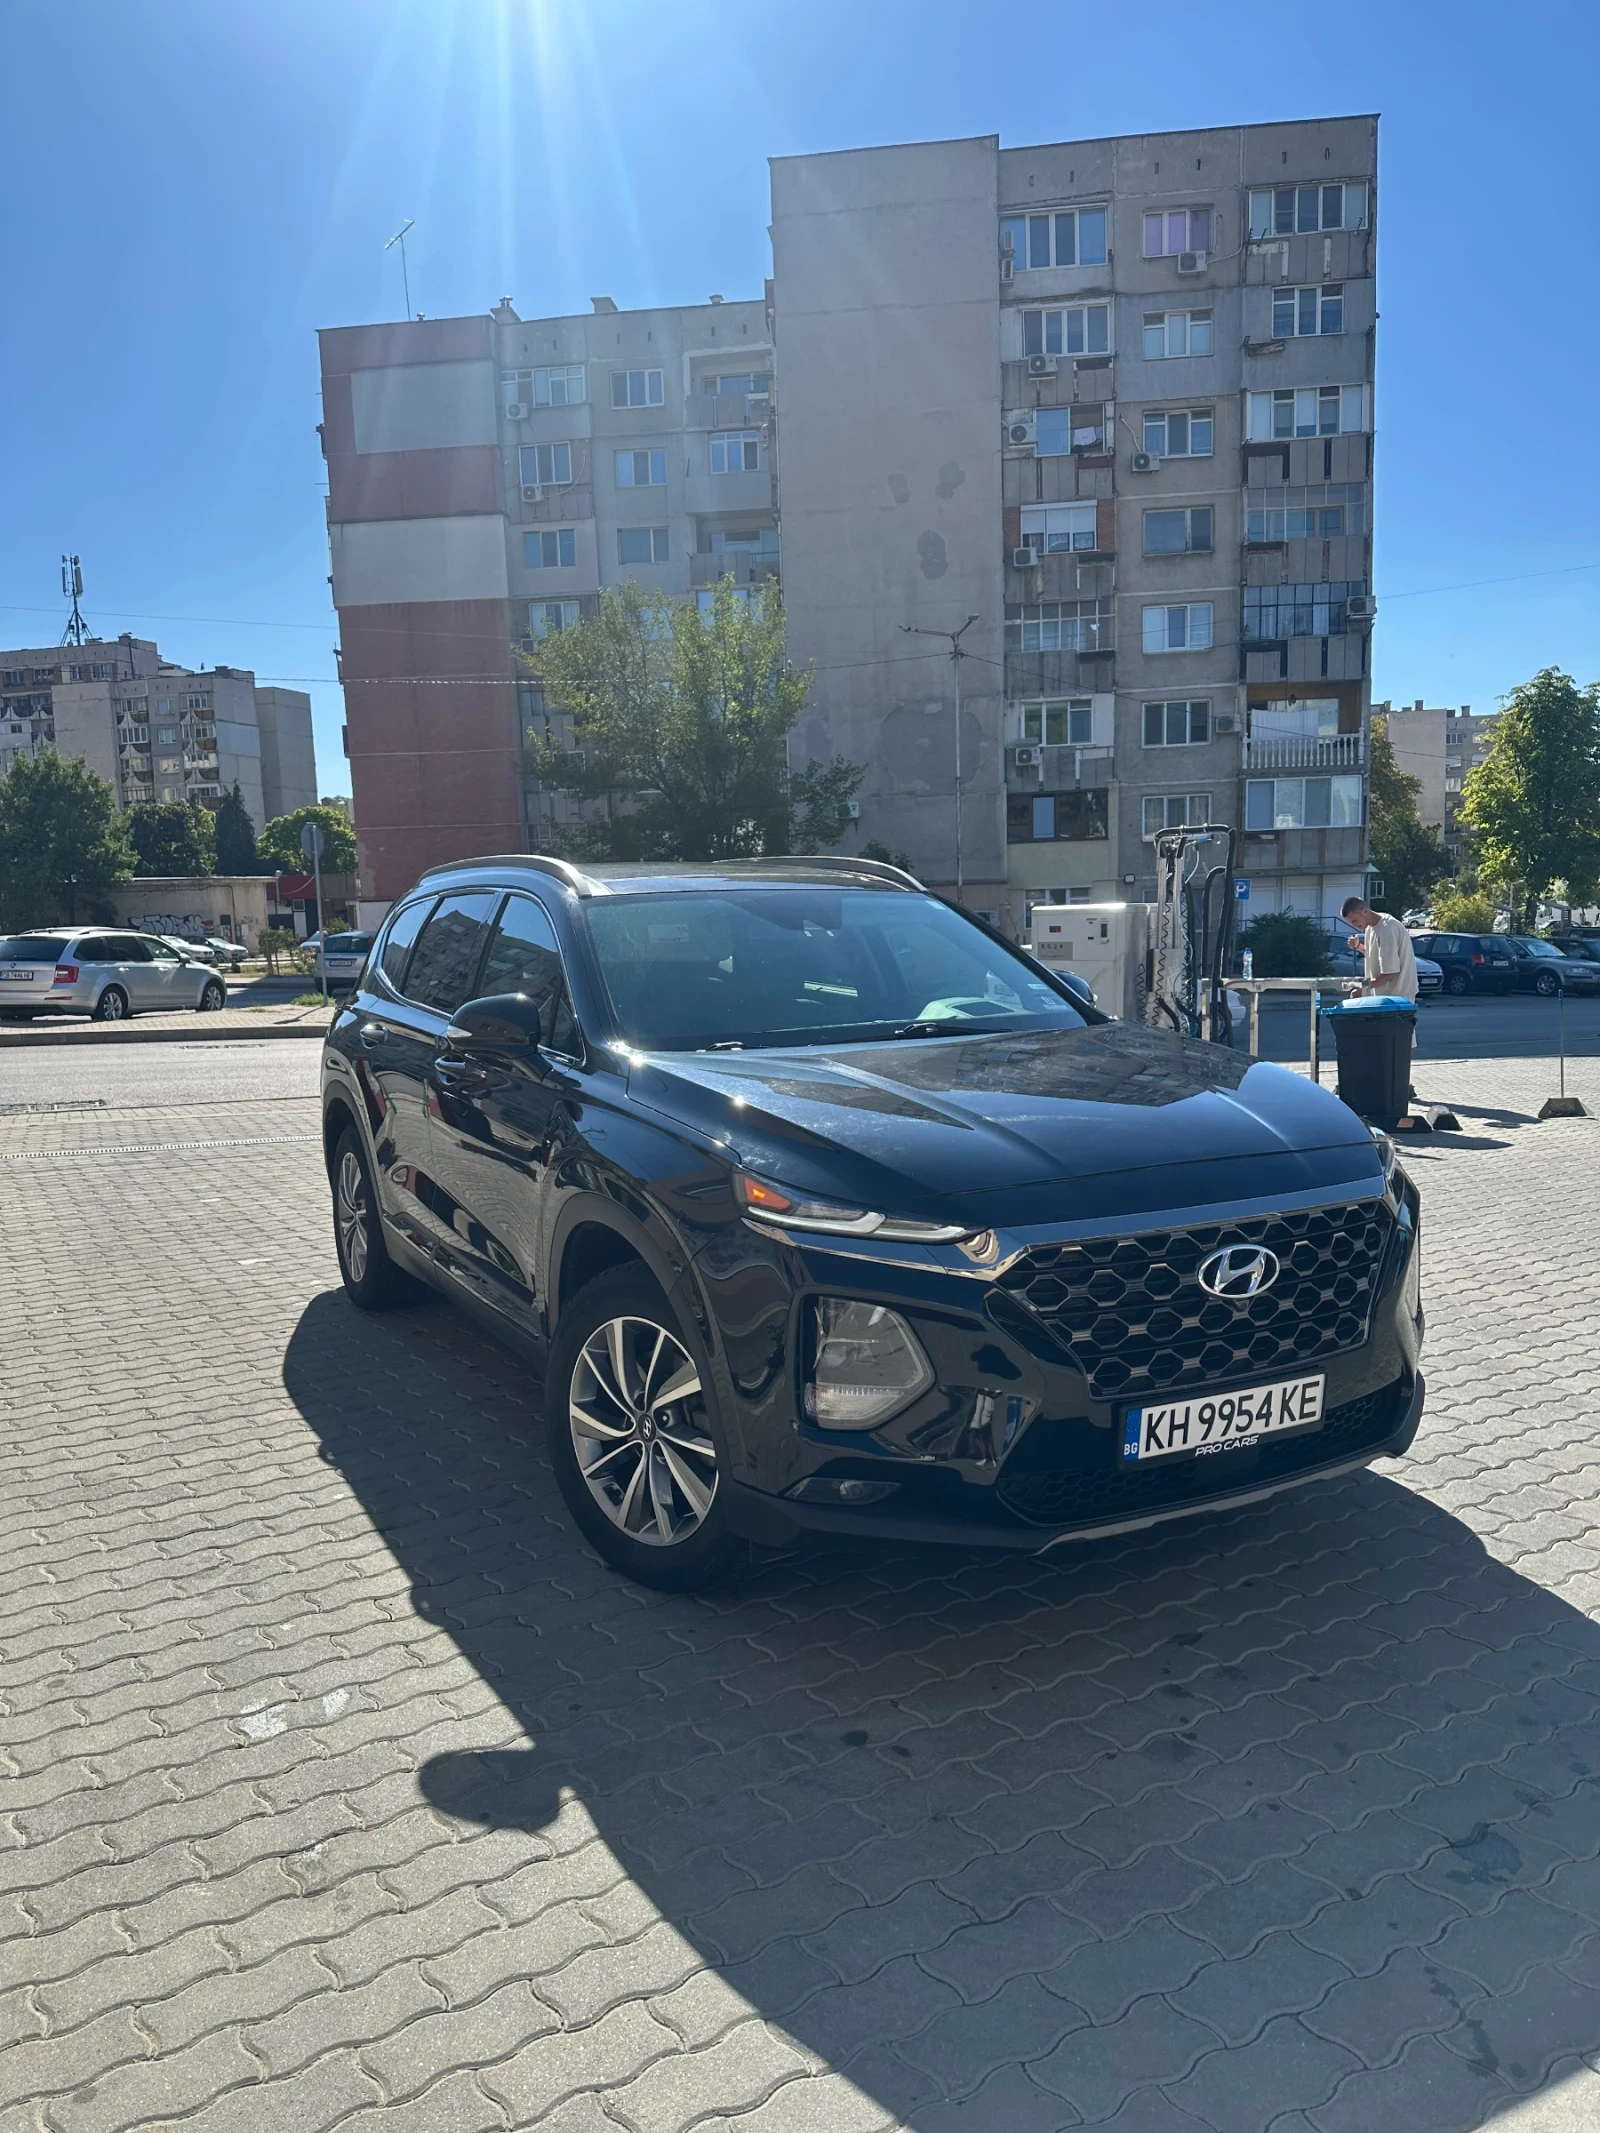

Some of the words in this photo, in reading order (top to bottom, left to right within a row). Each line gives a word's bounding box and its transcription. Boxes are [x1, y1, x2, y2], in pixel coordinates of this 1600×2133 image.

[1145, 1406, 1190, 1452] KH
[1198, 1390, 1273, 1441] 9954
[1279, 1381, 1320, 1424] KE
[1124, 1442, 1138, 1455] BG
[1195, 1443, 1222, 1457] PRO
[1224, 1435, 1259, 1450] CARS
